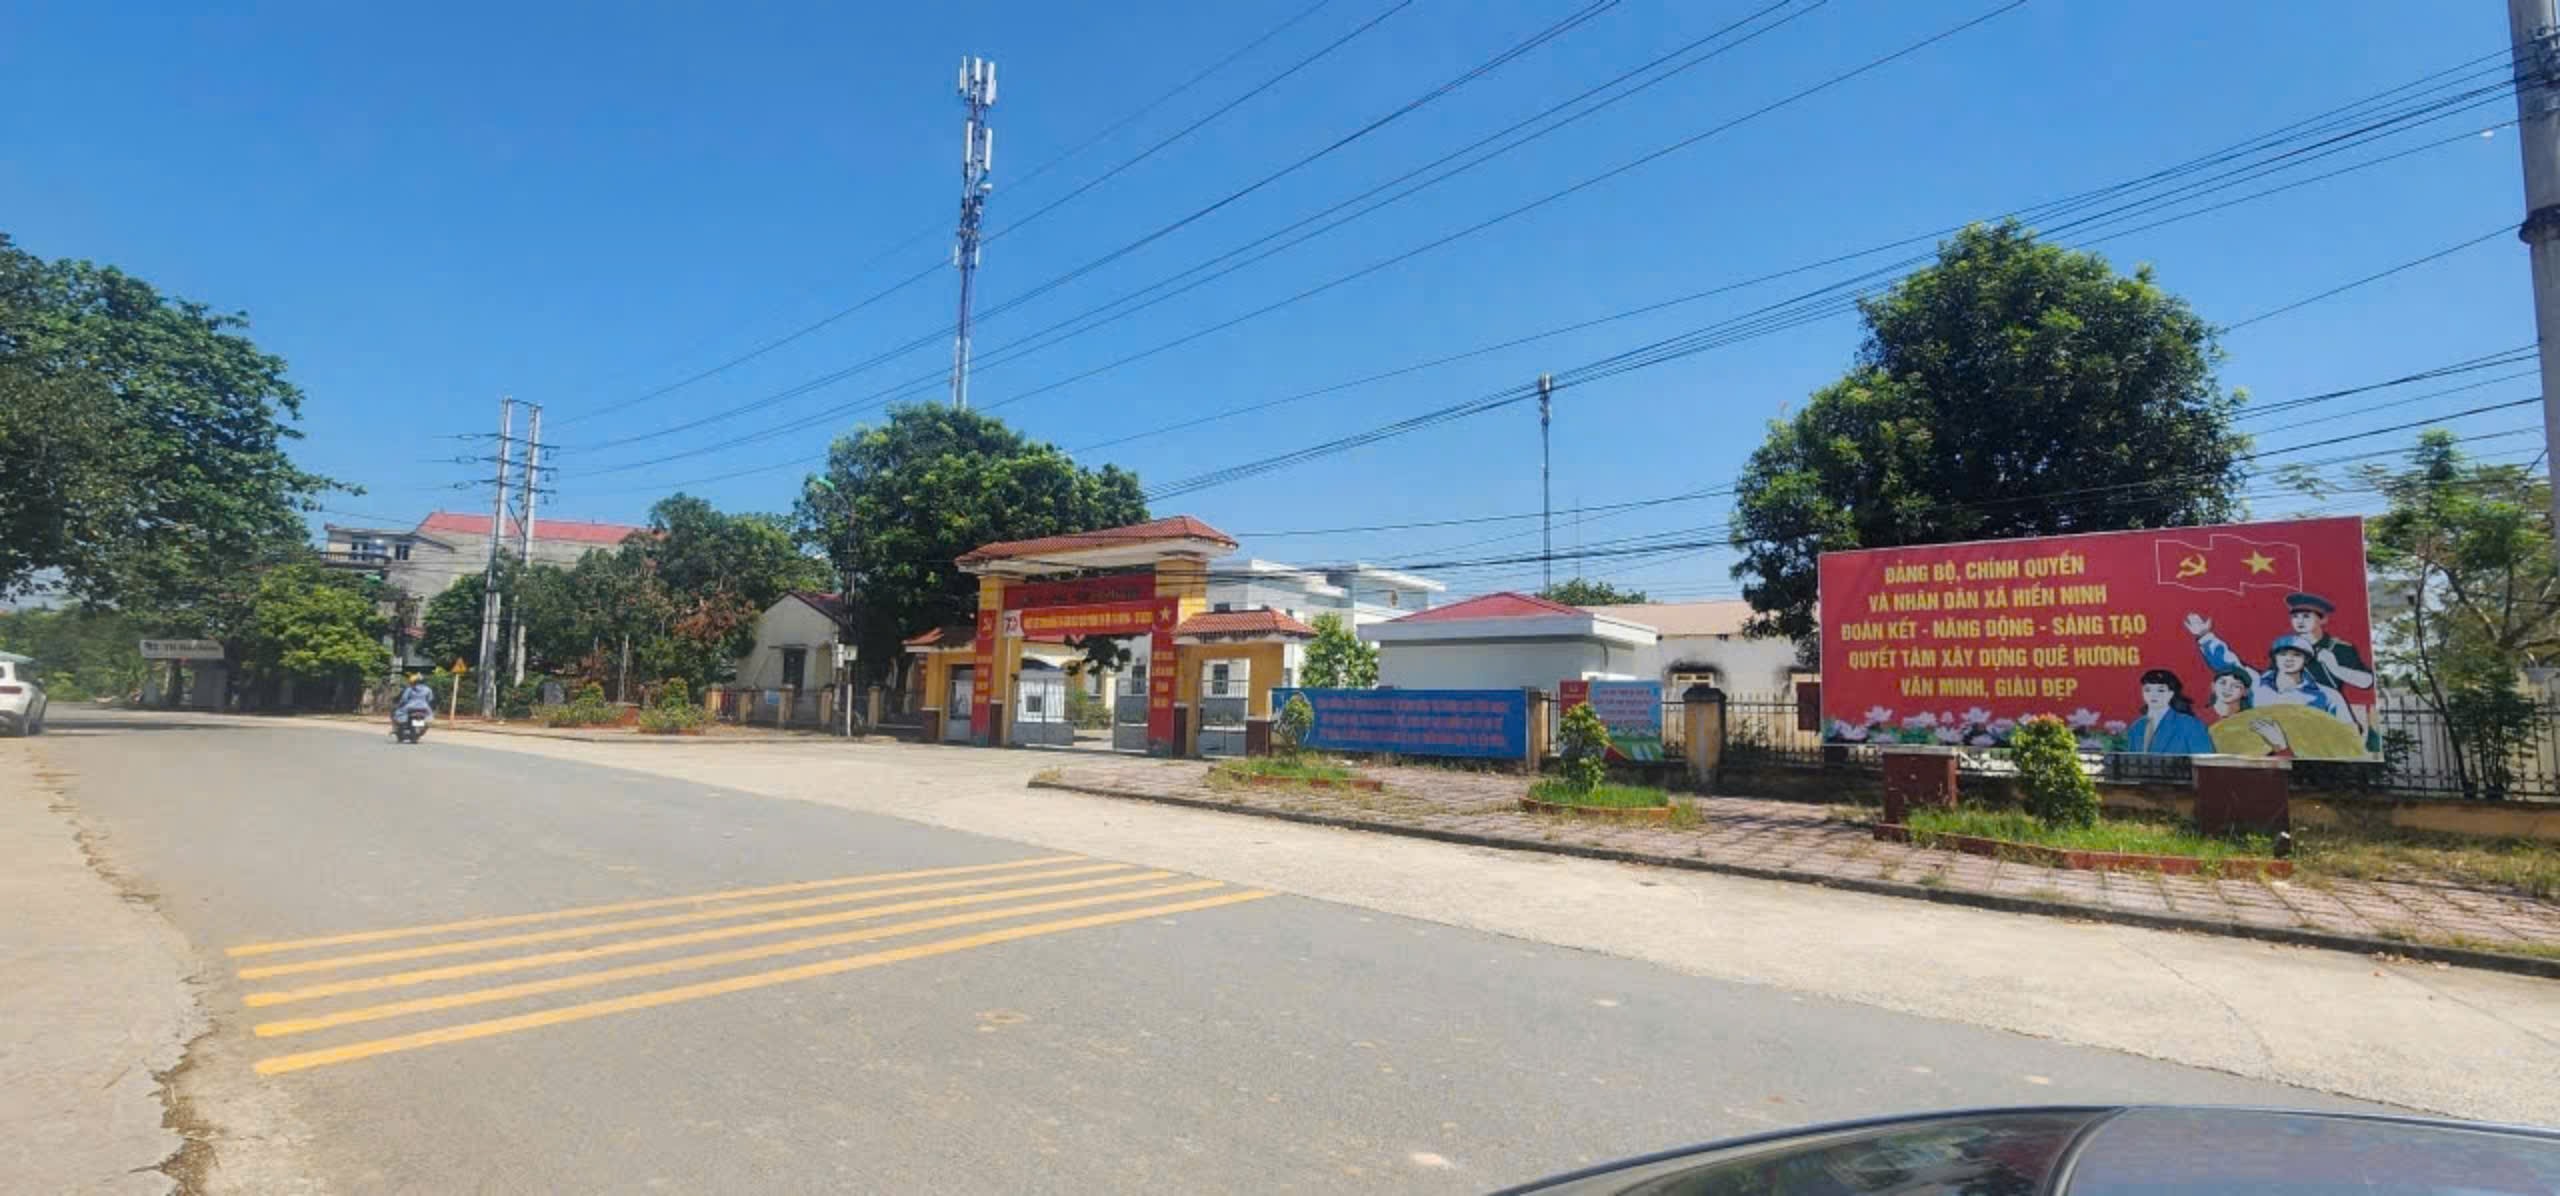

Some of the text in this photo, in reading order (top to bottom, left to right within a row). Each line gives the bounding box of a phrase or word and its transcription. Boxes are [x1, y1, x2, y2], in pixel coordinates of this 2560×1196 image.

[1886, 560, 1928, 584] ĐẢNG
[1966, 556, 2019, 579] CHÍNH
[1869, 593, 1889, 612] VÀ
[1893, 589, 1938, 611] NHÂN
[1944, 588, 1979, 608] DÂN
[2060, 584, 2107, 605] NINH
[1841, 619, 1883, 640] ĐOÀN
[1887, 616, 1918, 639] KẾT
[1933, 617, 1981, 639] NĂNG
[1985, 614, 2035, 641] ĐỘNG
[2053, 613, 2103, 634] SÁNG
[2110, 614, 2146, 638] TẠO
[1849, 644, 2140, 671] QUYẾT TÂM XÂY DỰNG QUÊ HƯƠNG
[1902, 674, 2077, 700] VĂN MINH, GIÀU ĐẸP
